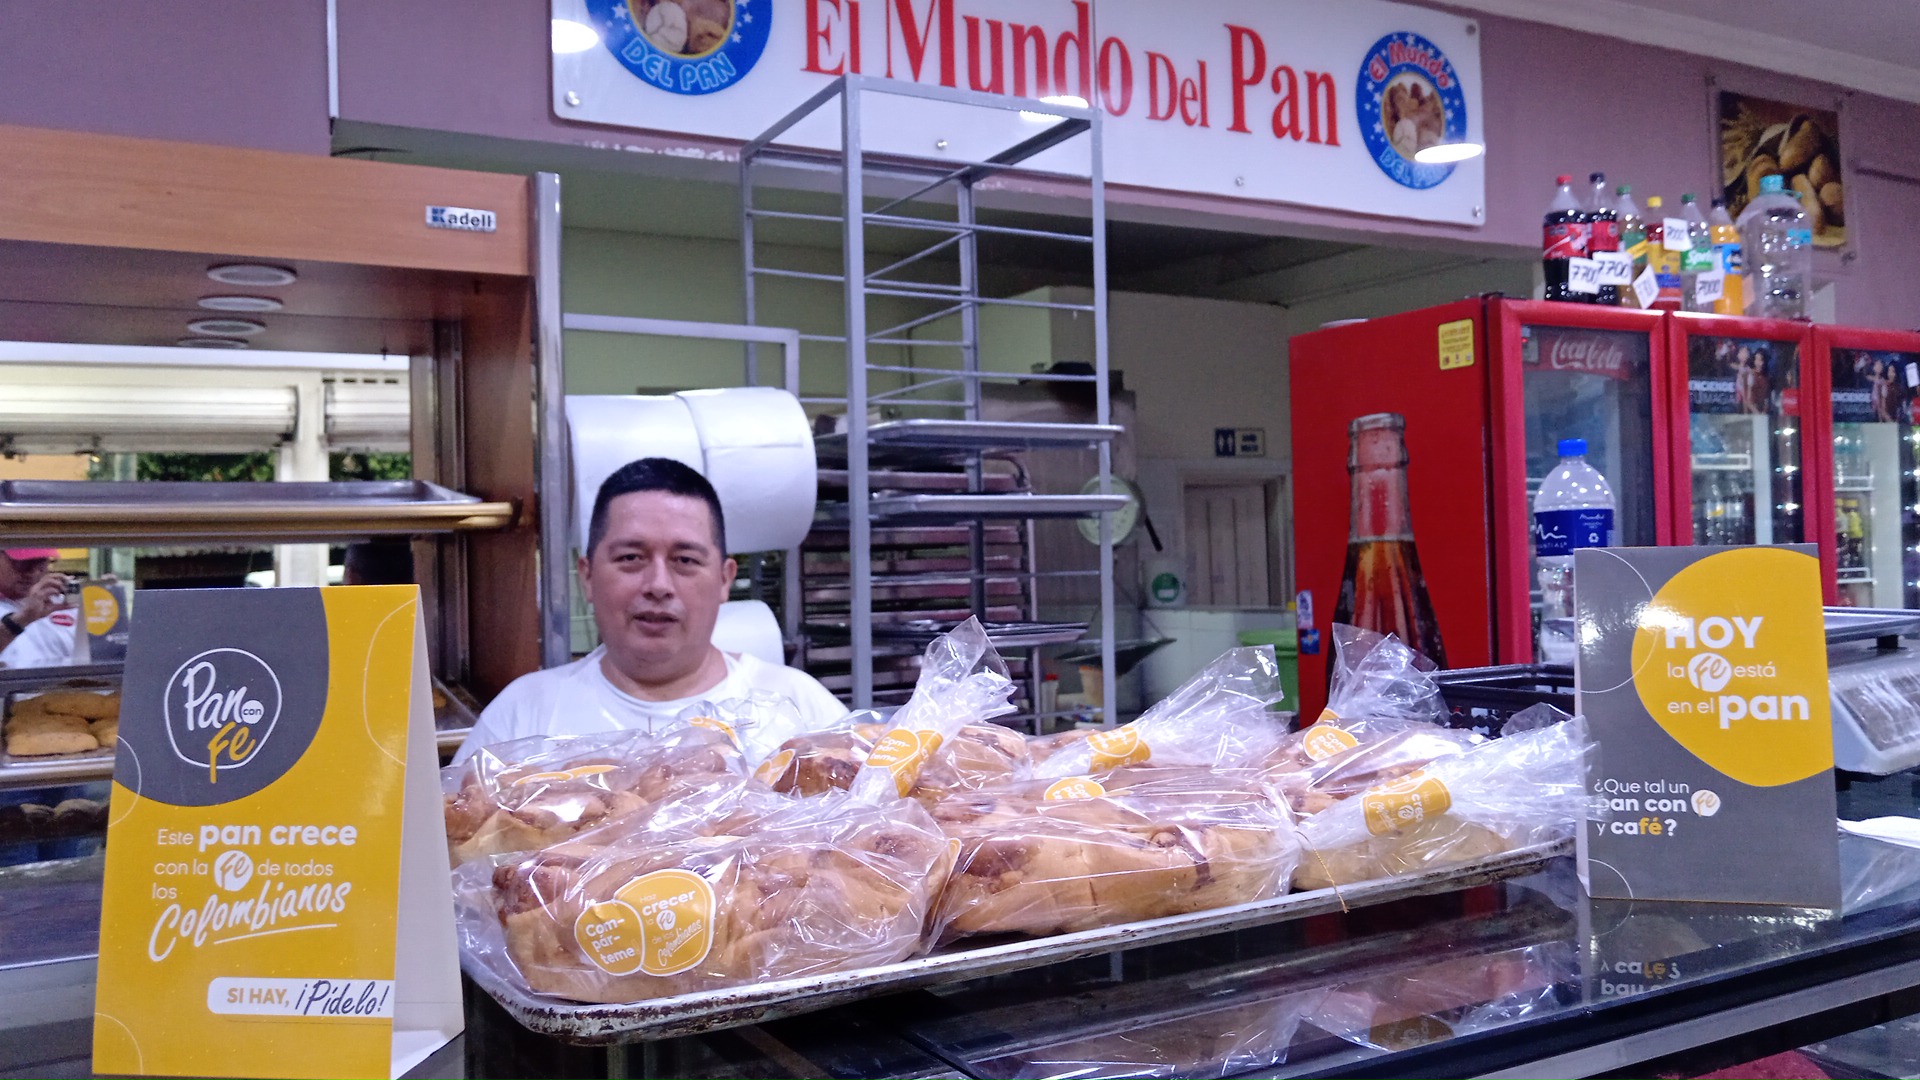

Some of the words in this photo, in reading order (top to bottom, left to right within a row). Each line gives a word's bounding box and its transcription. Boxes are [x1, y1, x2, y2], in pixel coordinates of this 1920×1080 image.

[621, 36, 674, 88] DEL
[679, 52, 737, 91] PAN
[801, 0, 861, 76] El
[886, 0, 1133, 117] Mundo
[1145, 51, 1210, 128] Del
[1224, 23, 1341, 147] Pan
[1388, 40, 1450, 88] Mundo
[431, 207, 493, 228] Kadell
[1665, 616, 1764, 649] HOY
[1667, 662, 1685, 678] la
[1734, 661, 1776, 678] está
[182, 661, 248, 731] Pan
[243, 707, 262, 716] con
[1667, 701, 1692, 713] en
[1697, 697, 1714, 713] el
[1718, 694, 1810, 729] pan
[1645, 779, 1665, 793] tal
[1669, 782, 1690, 794] un
[1645, 798, 1687, 812] con
[157, 829, 194, 845] Este
[198, 825, 261, 852] pan
[269, 825, 358, 845] crece
[1597, 822, 1606, 836] y
[154, 862, 188, 875] con
[193, 858, 208, 875] la
[257, 858, 281, 876] de
[284, 858, 334, 876] todos
[152, 882, 177, 899] los
[642, 889, 696, 916] crecer
[149, 880, 352, 962] Colombianos
[585, 918, 625, 937] Com-
[227, 988, 243, 1003] SI
[249, 988, 290, 1008] HAY,
[295, 980, 390, 1015] ¡Pídelo!
